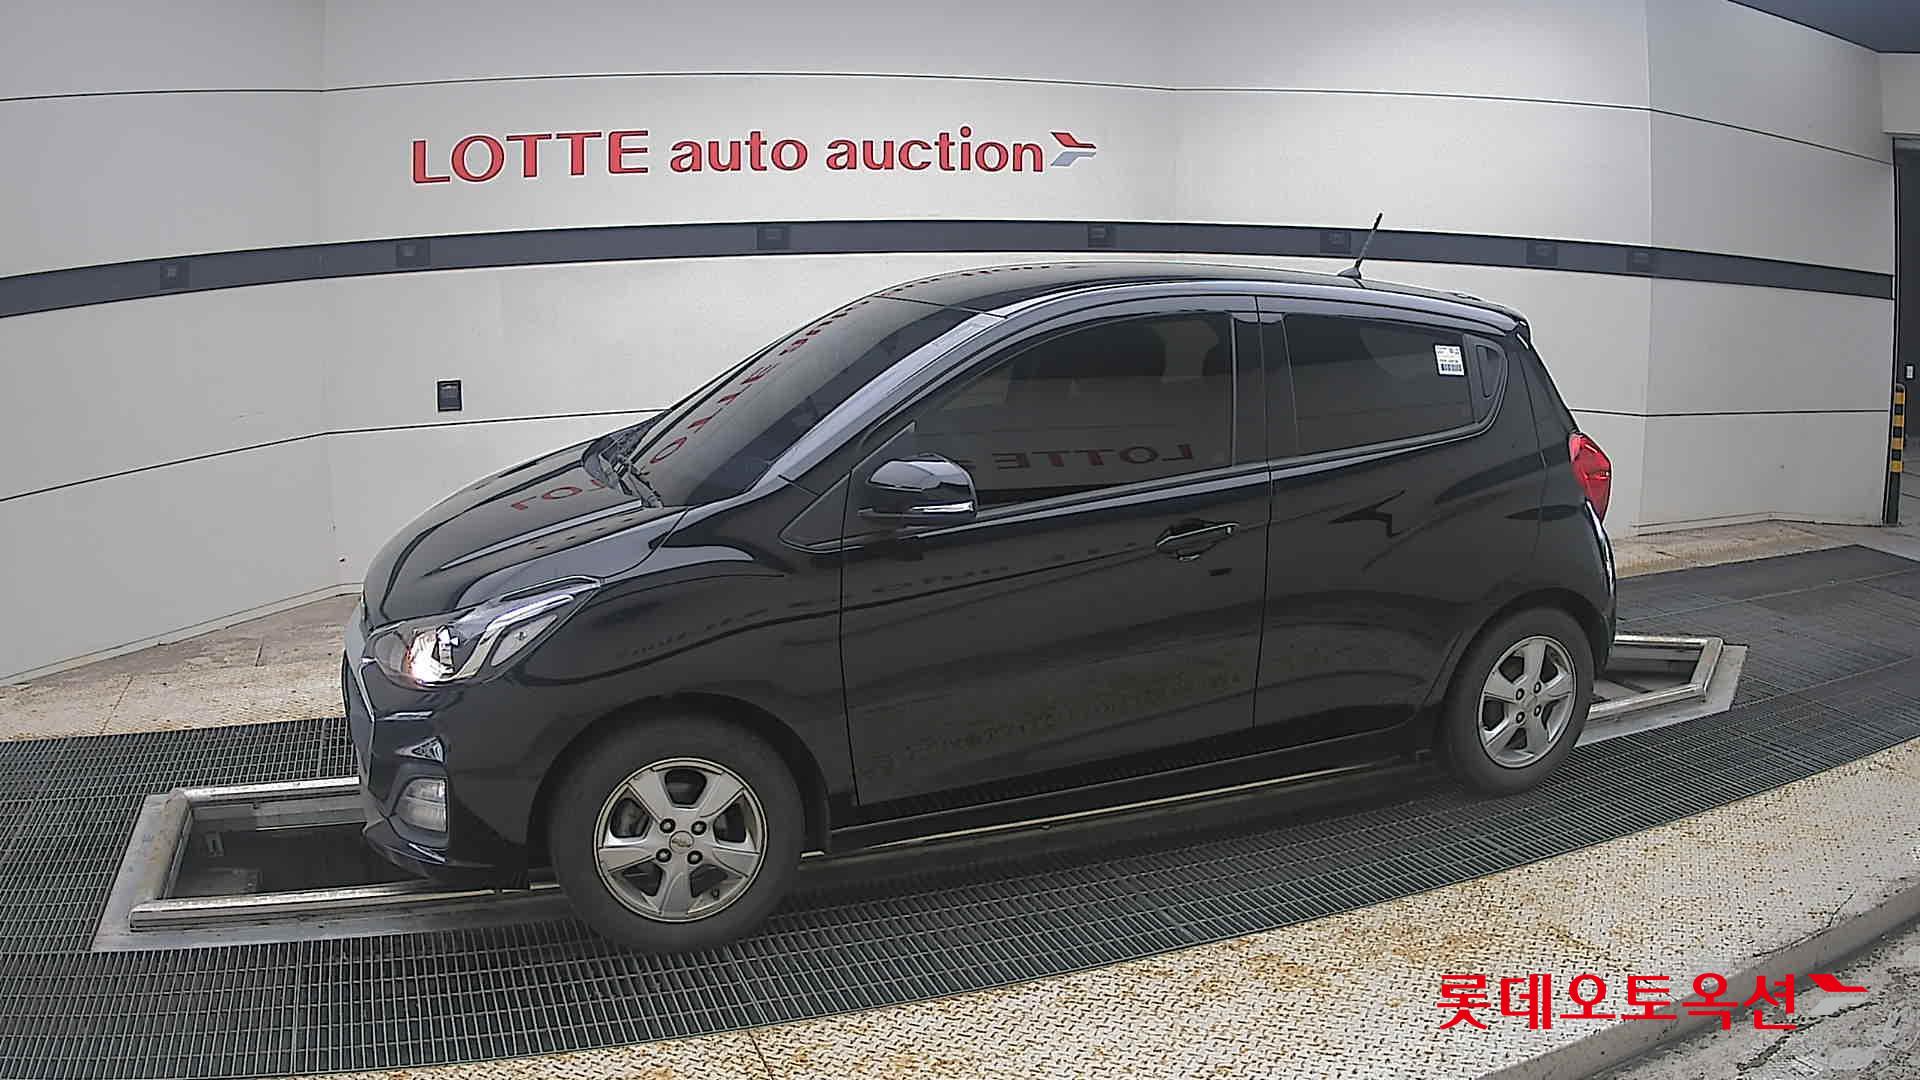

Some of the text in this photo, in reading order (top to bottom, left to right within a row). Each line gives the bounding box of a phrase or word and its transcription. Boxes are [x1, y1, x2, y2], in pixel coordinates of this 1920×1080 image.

[411, 126, 1044, 184] LOTTE auto auction
